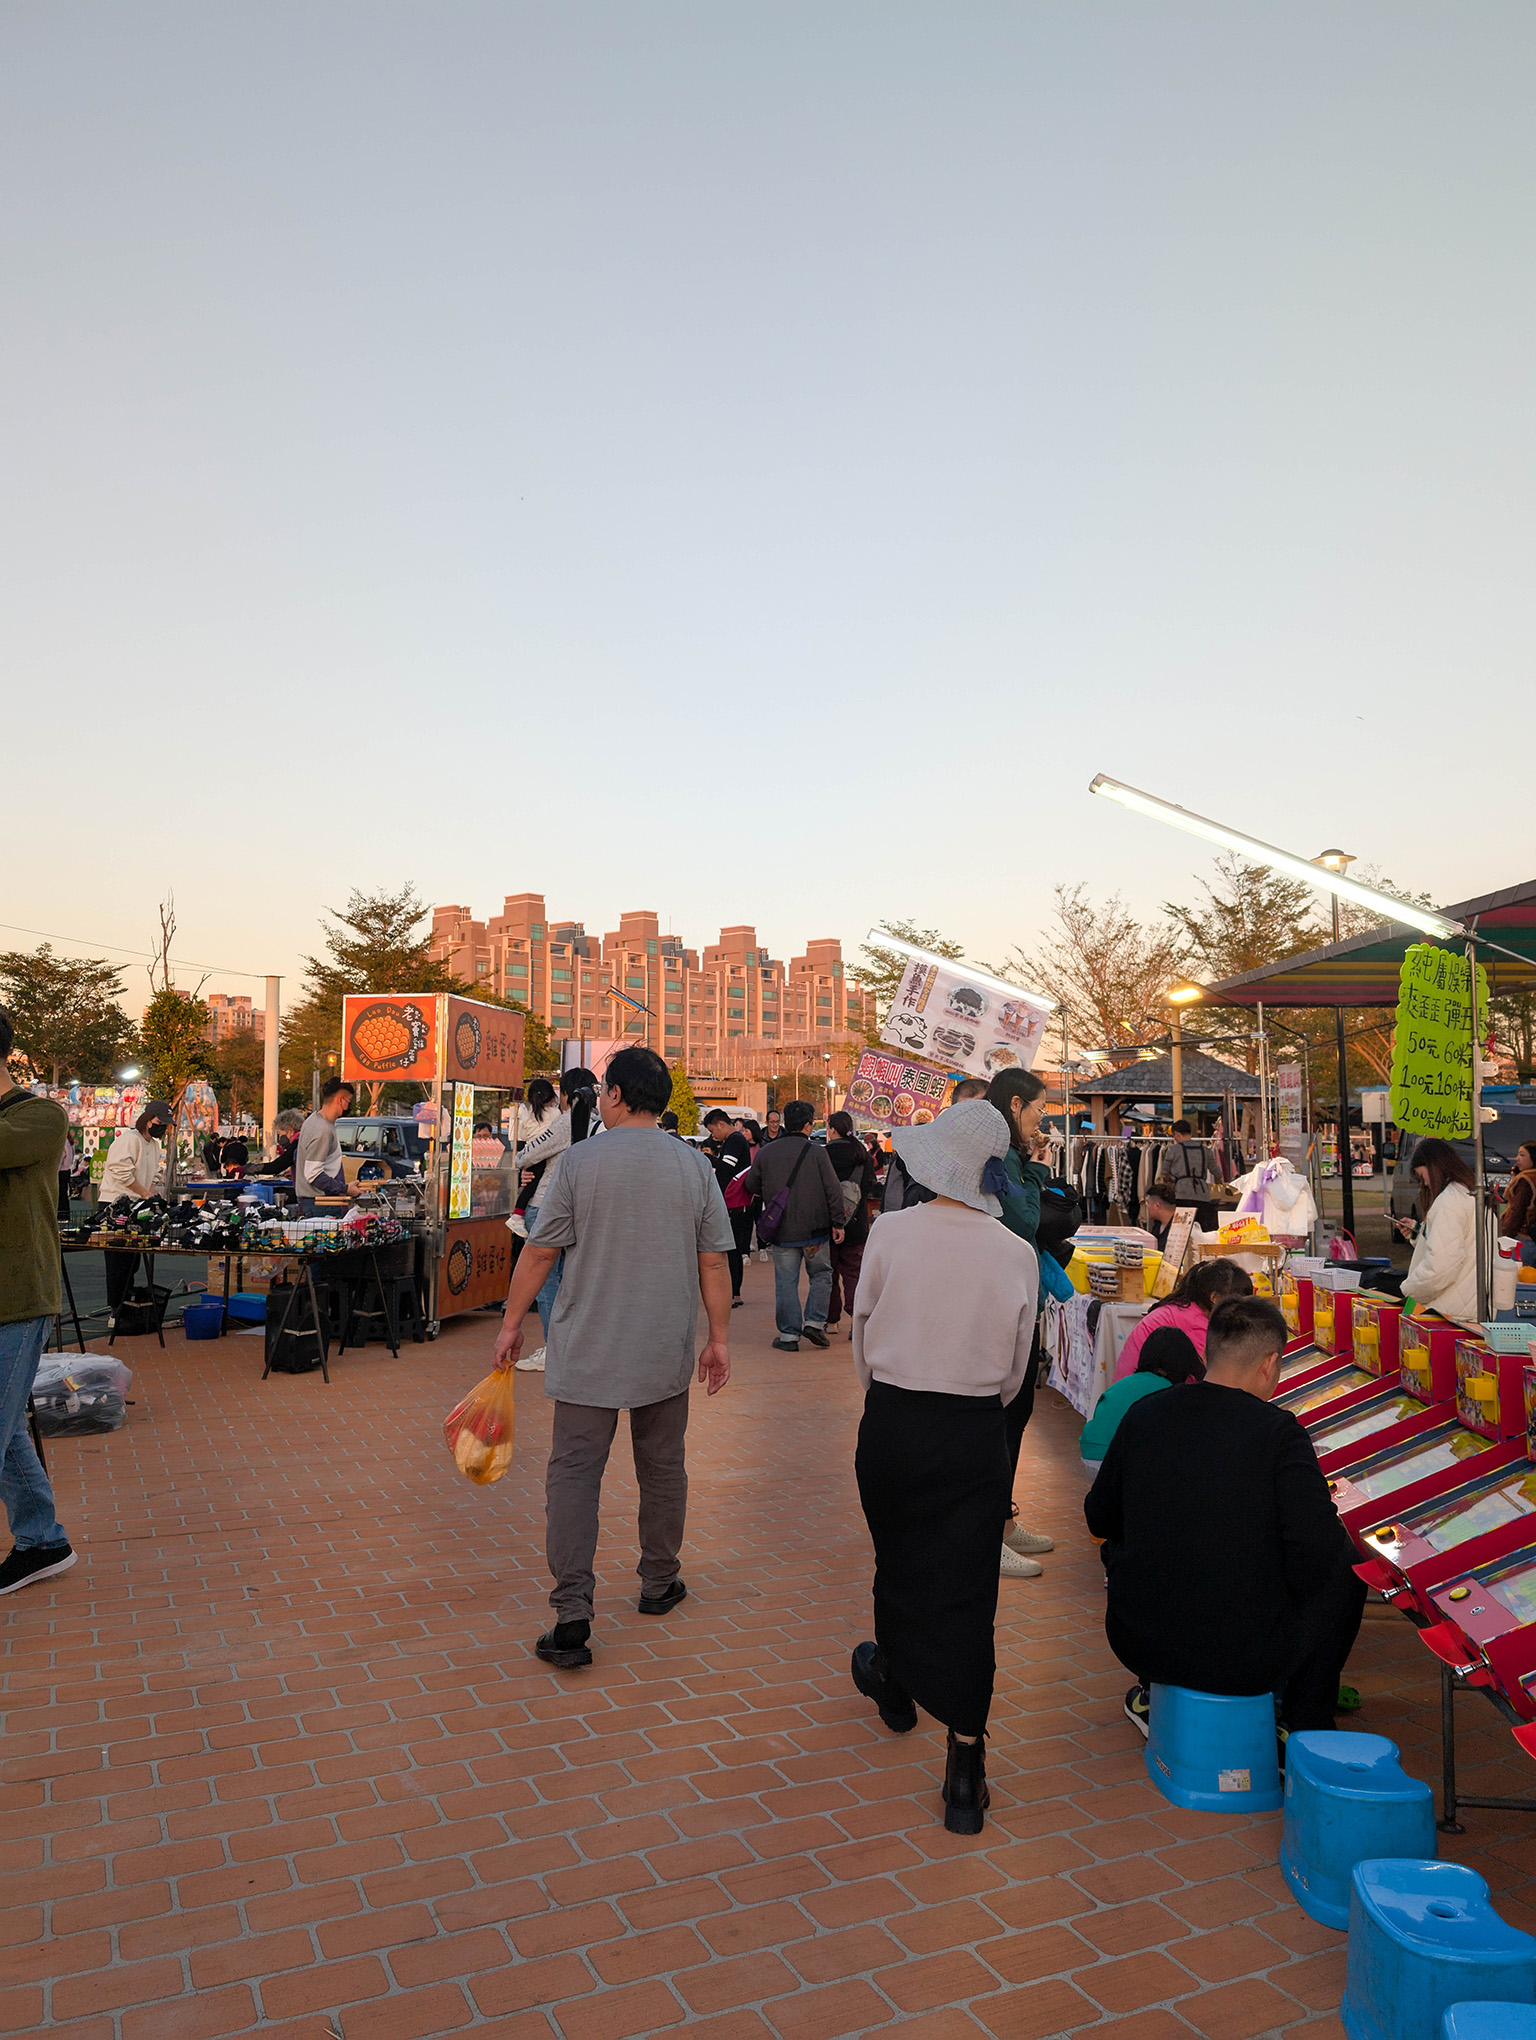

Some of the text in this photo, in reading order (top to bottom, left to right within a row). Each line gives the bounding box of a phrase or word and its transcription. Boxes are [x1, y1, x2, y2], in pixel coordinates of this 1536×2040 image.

[903, 962, 928, 1009] 摸魚手作
[1409, 952, 1480, 993] 純屬娛樂
[366, 1006, 400, 1018] Lao Dou
[359, 1053, 371, 1066] Egg
